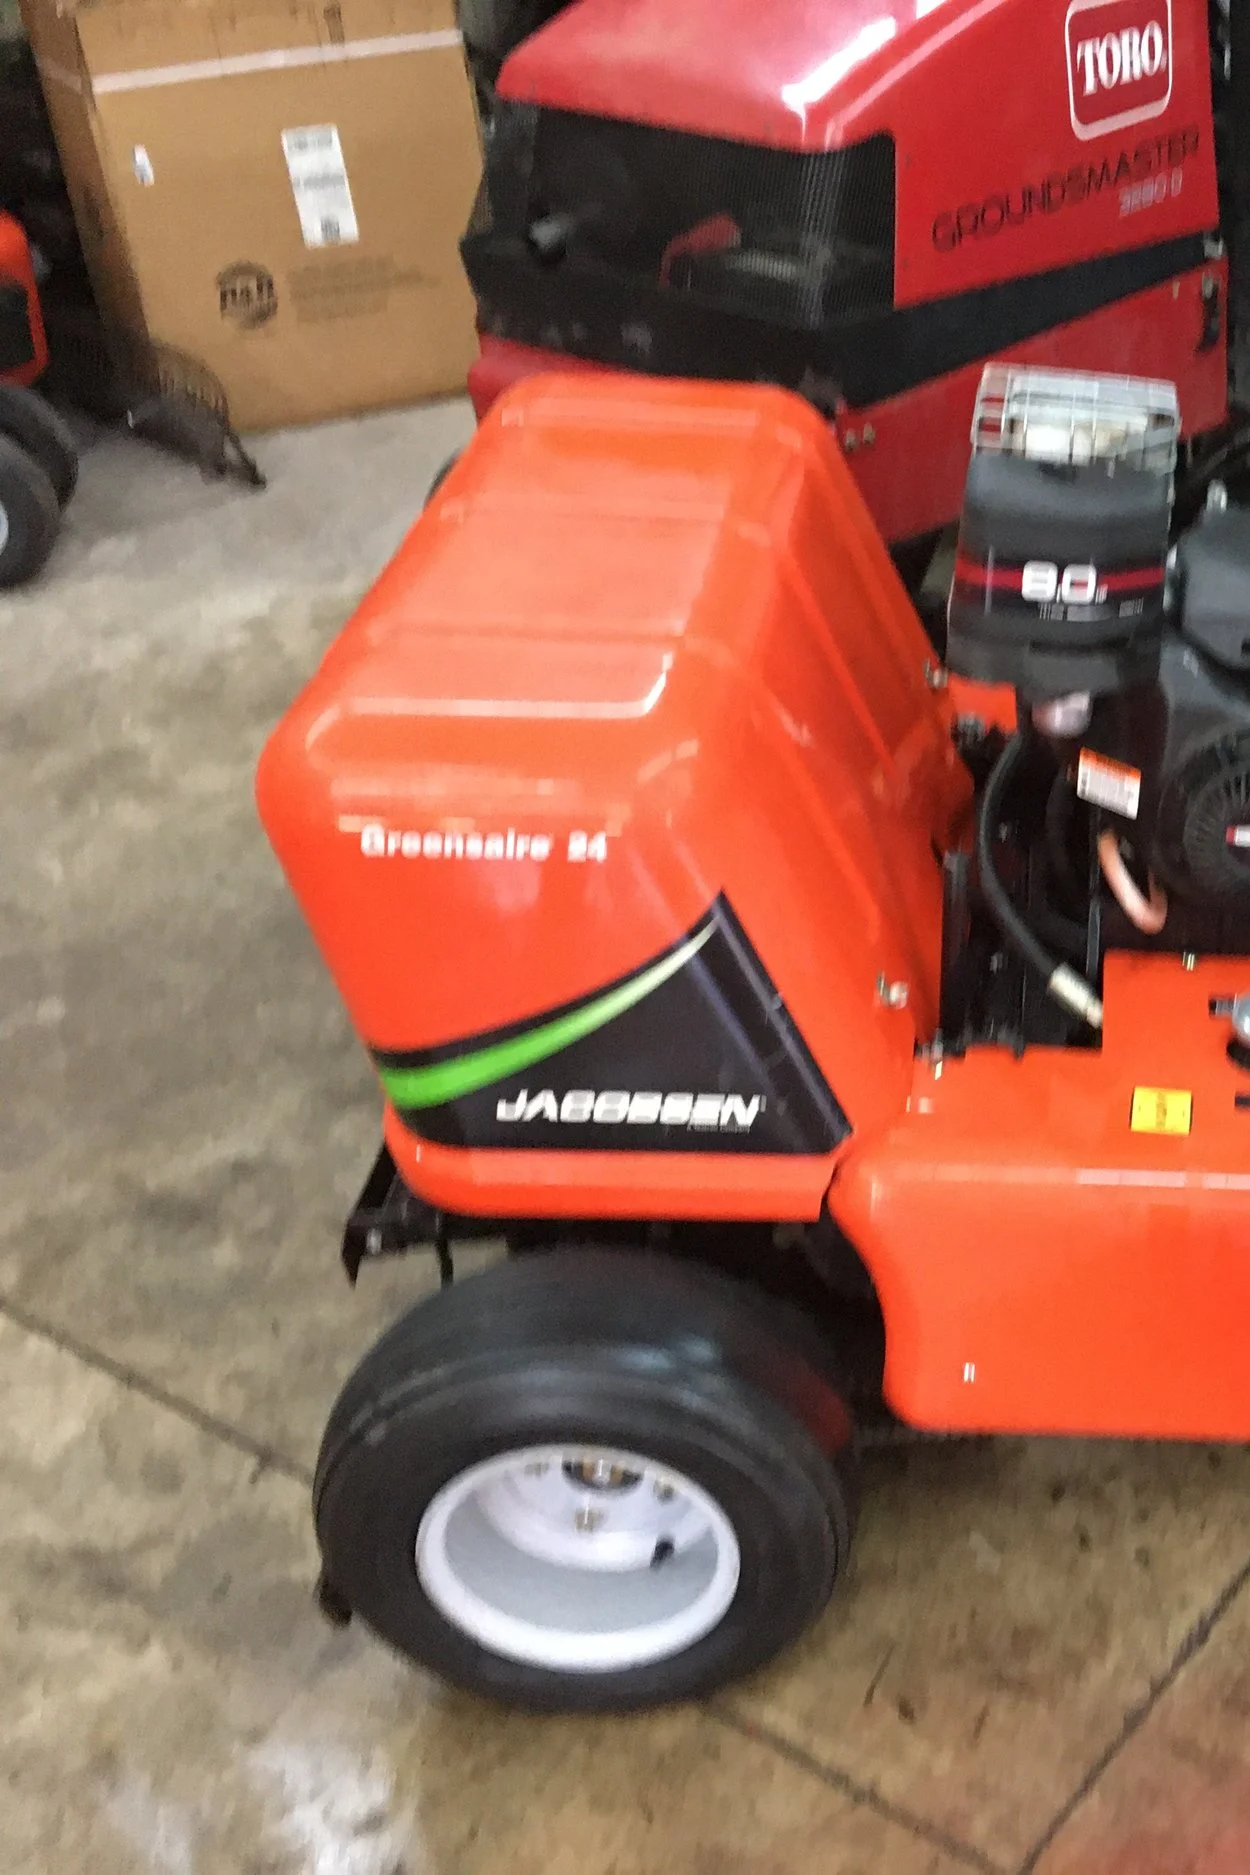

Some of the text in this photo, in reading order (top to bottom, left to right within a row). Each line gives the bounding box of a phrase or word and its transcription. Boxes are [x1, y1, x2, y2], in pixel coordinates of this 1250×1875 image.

[1077, 20, 1164, 97] TORO
[931, 124, 1200, 253] GROUNDSMASTER
[496, 1086, 762, 1128] JACOBSEN
